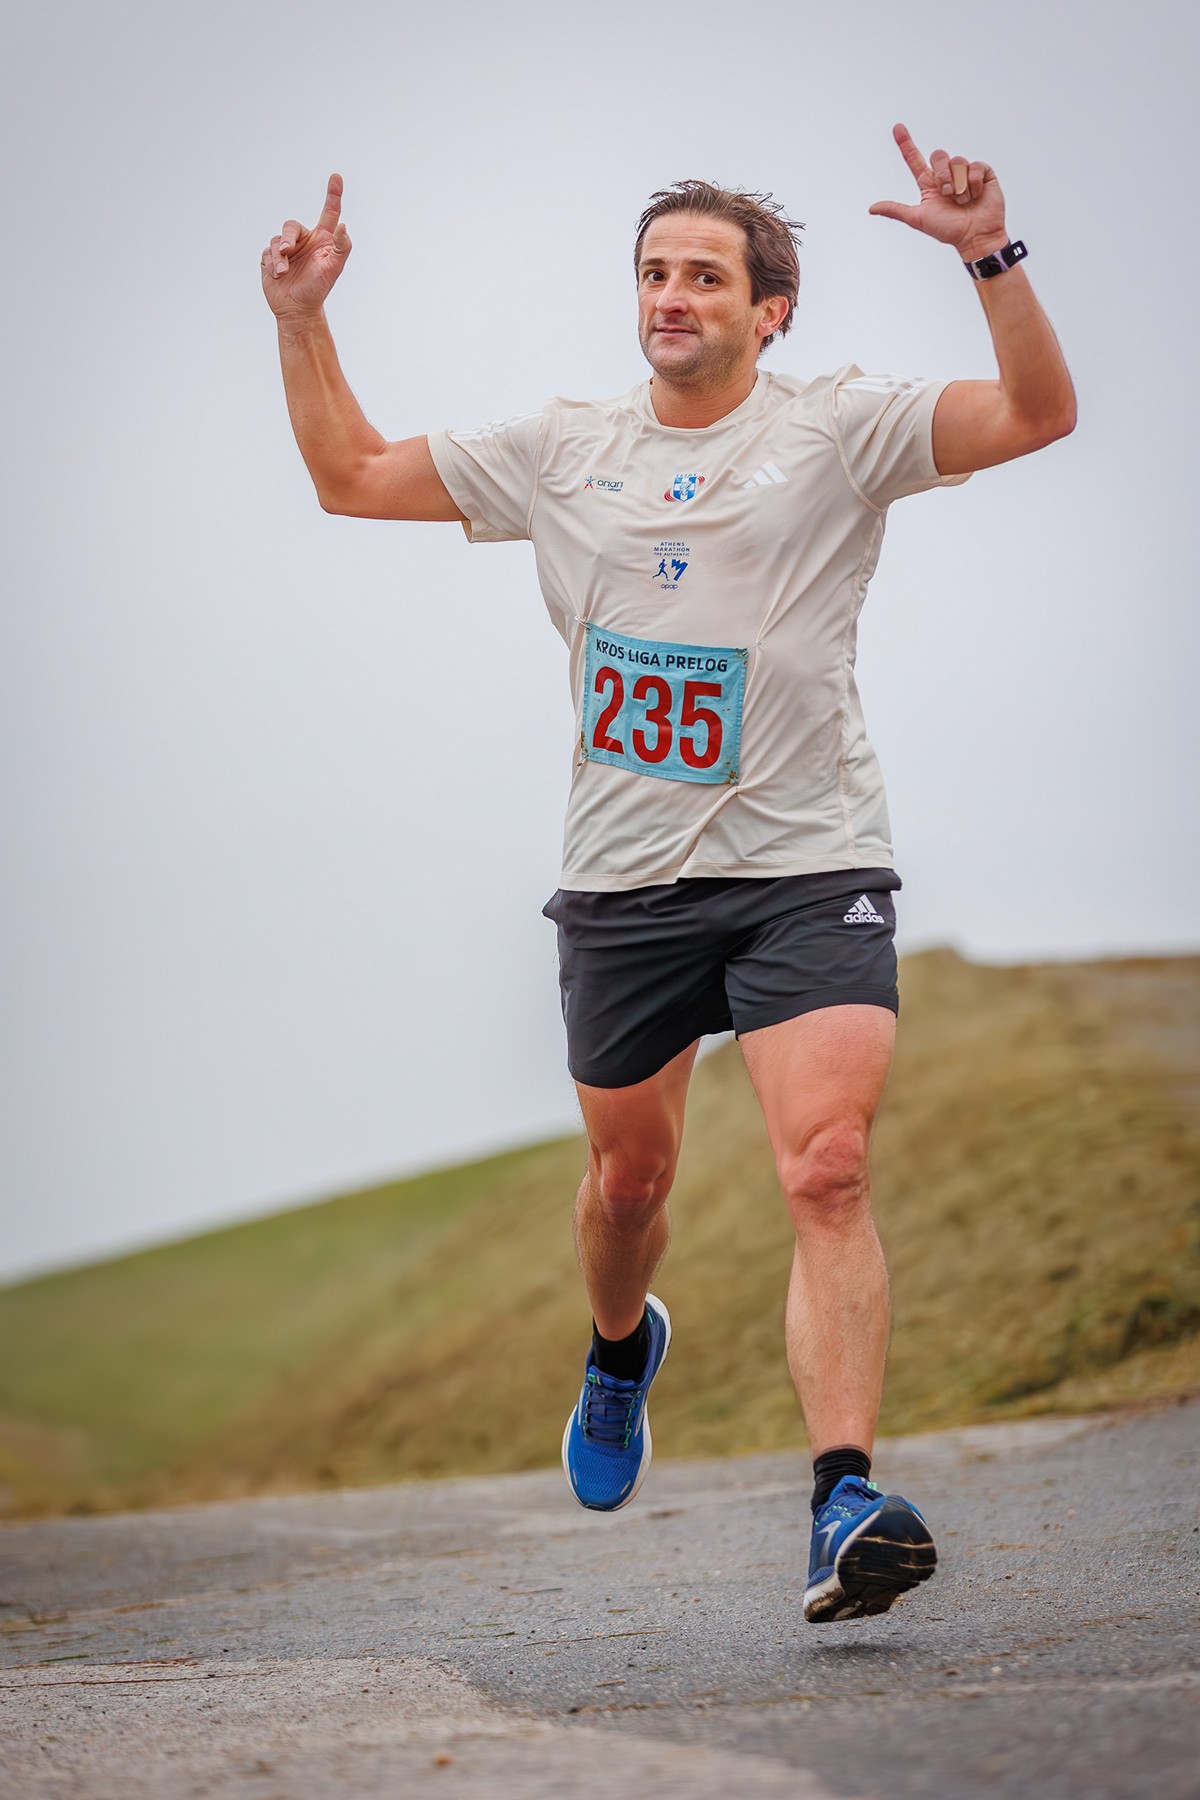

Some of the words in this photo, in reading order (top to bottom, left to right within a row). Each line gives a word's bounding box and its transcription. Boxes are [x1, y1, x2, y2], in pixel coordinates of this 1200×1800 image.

[596, 638, 625, 659] KROS
[628, 649, 661, 667] LIGA
[665, 654, 728, 672] PRELOG
[592, 665, 723, 769] 235
[843, 911, 885, 923] adidas
